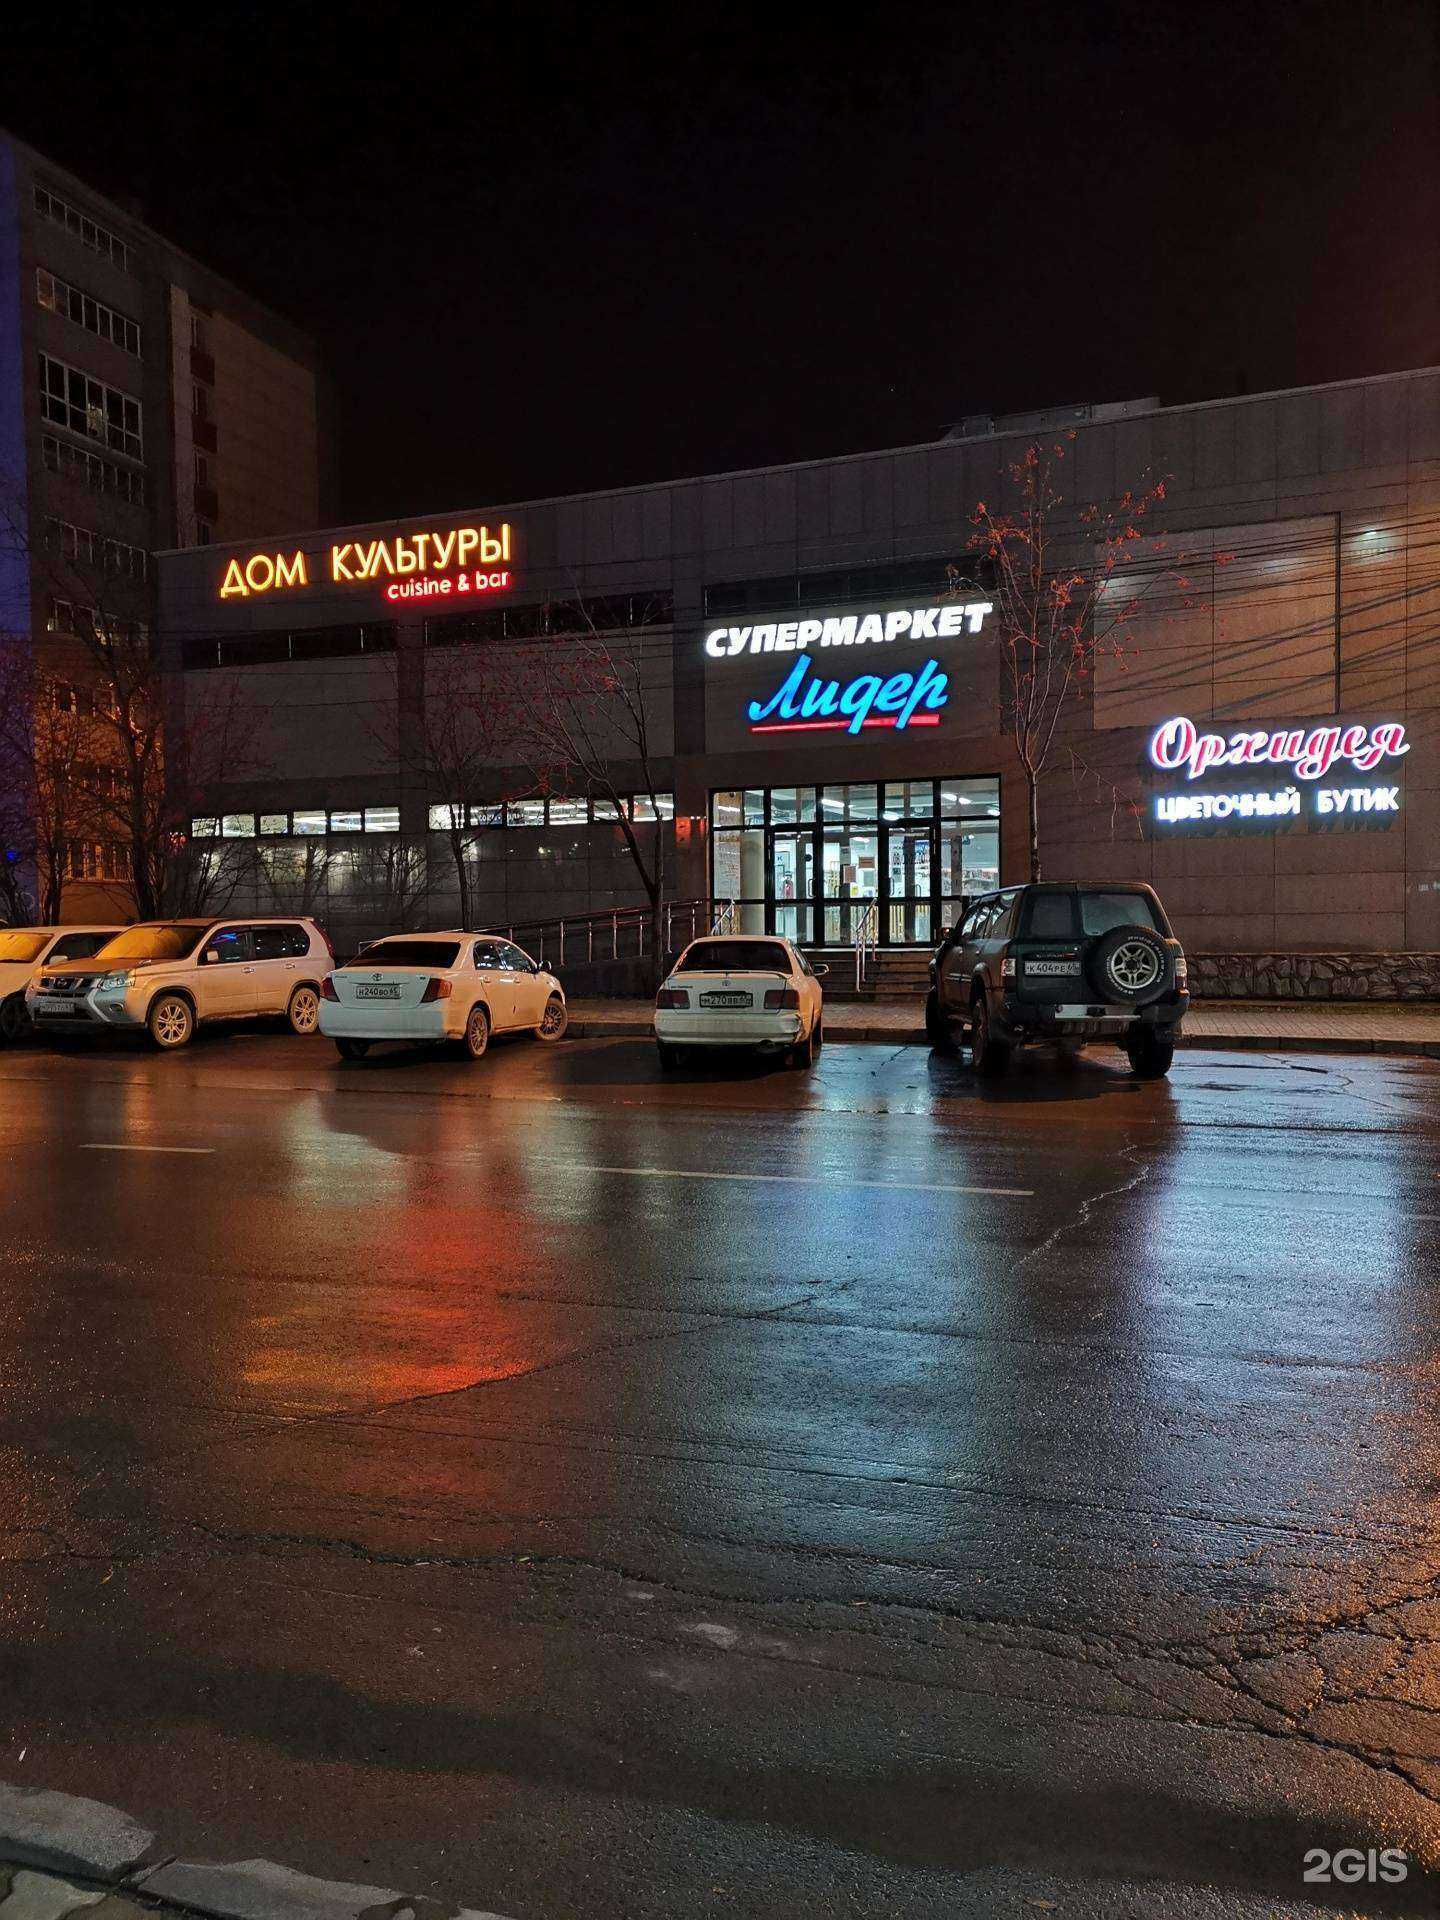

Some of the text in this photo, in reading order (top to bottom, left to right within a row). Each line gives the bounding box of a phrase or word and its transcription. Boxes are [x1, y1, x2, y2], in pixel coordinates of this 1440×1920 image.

[220, 523, 511, 599] ДОМ КУЛЬТУРЫ
[387, 570, 510, 600] cuisine & bar
[705, 602, 994, 658] СУПЕРМАРКЕТ
[748, 653, 949, 735] Лидер
[1151, 716, 1411, 780] Орхидея
[1156, 786, 1400, 824] ЦВЕТОЧНЫЙ БУТИК
